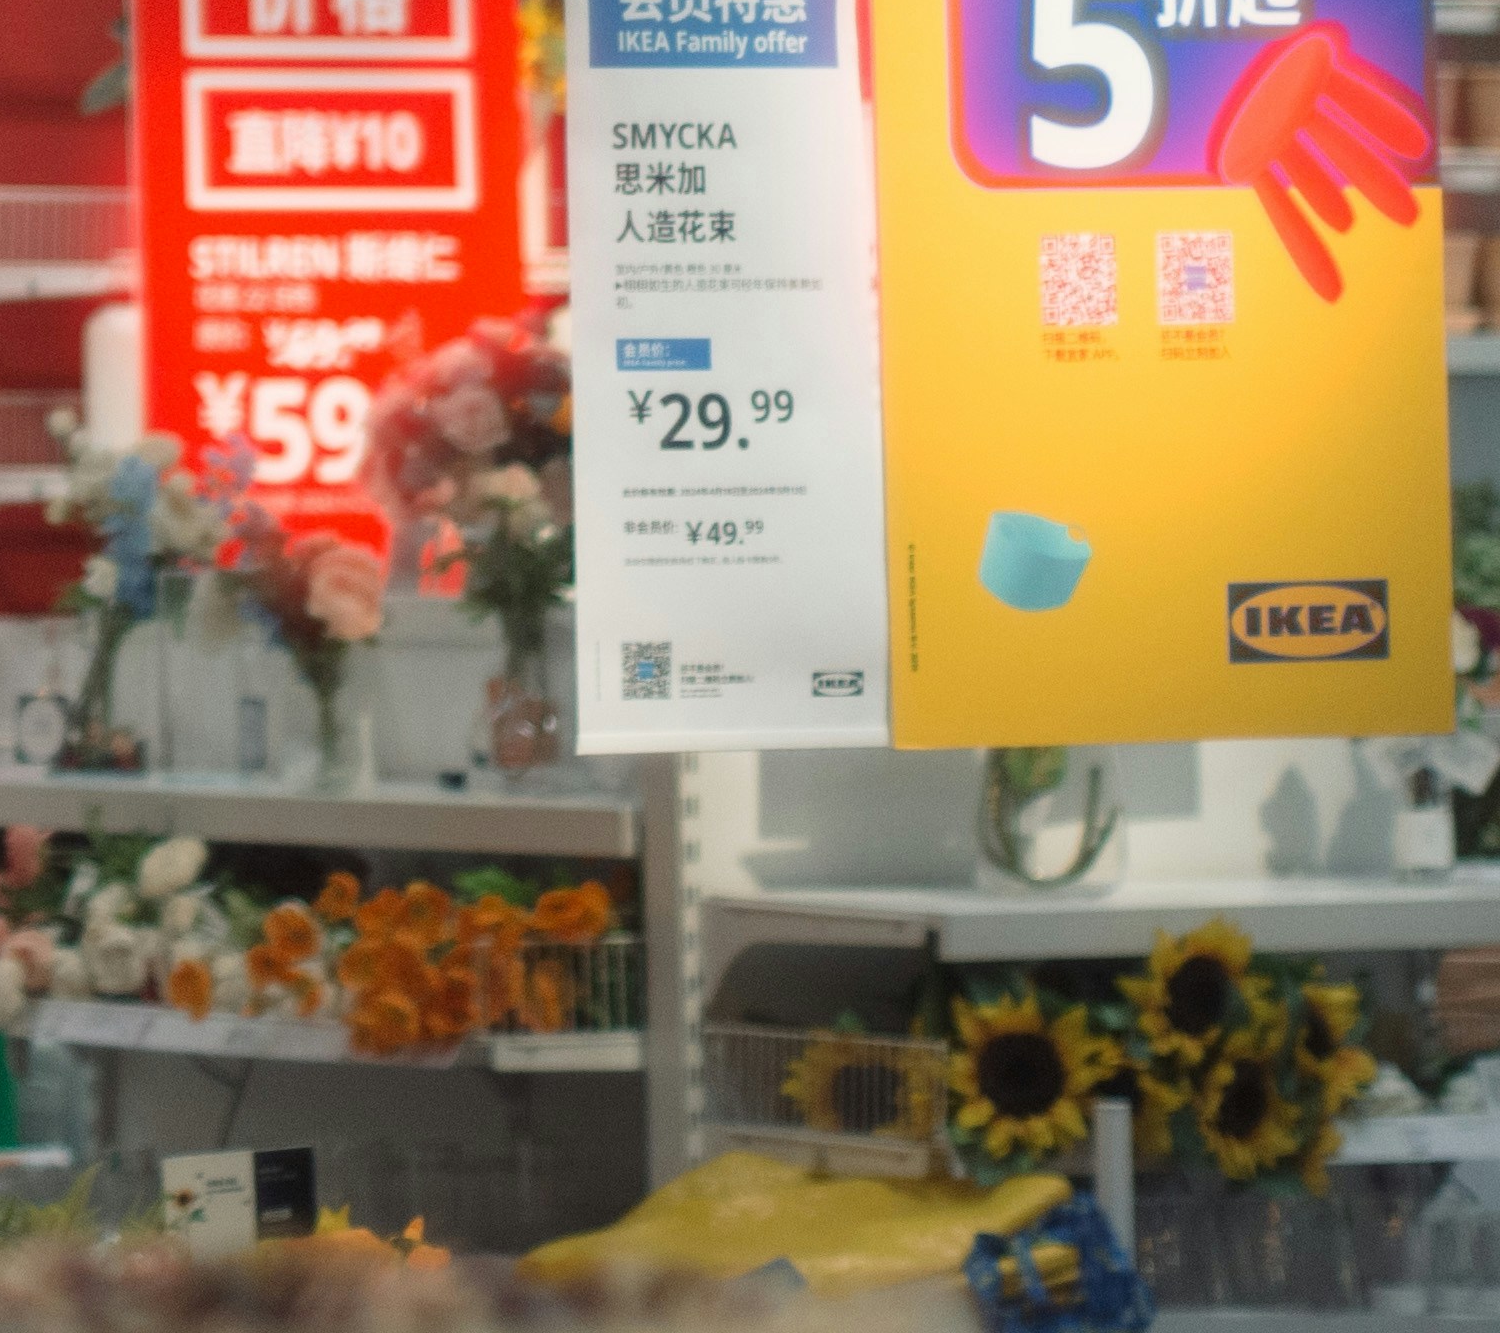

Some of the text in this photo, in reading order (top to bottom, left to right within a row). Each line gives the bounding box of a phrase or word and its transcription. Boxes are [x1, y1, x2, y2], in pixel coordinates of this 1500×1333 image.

[618, 30, 808, 60] IKEA Family offer
[611, 122, 738, 150] SMYCKA
[615, 162, 707, 195] 思米加
[616, 209, 737, 243] 人造花束
[1245, 604, 1376, 638] IKEA
